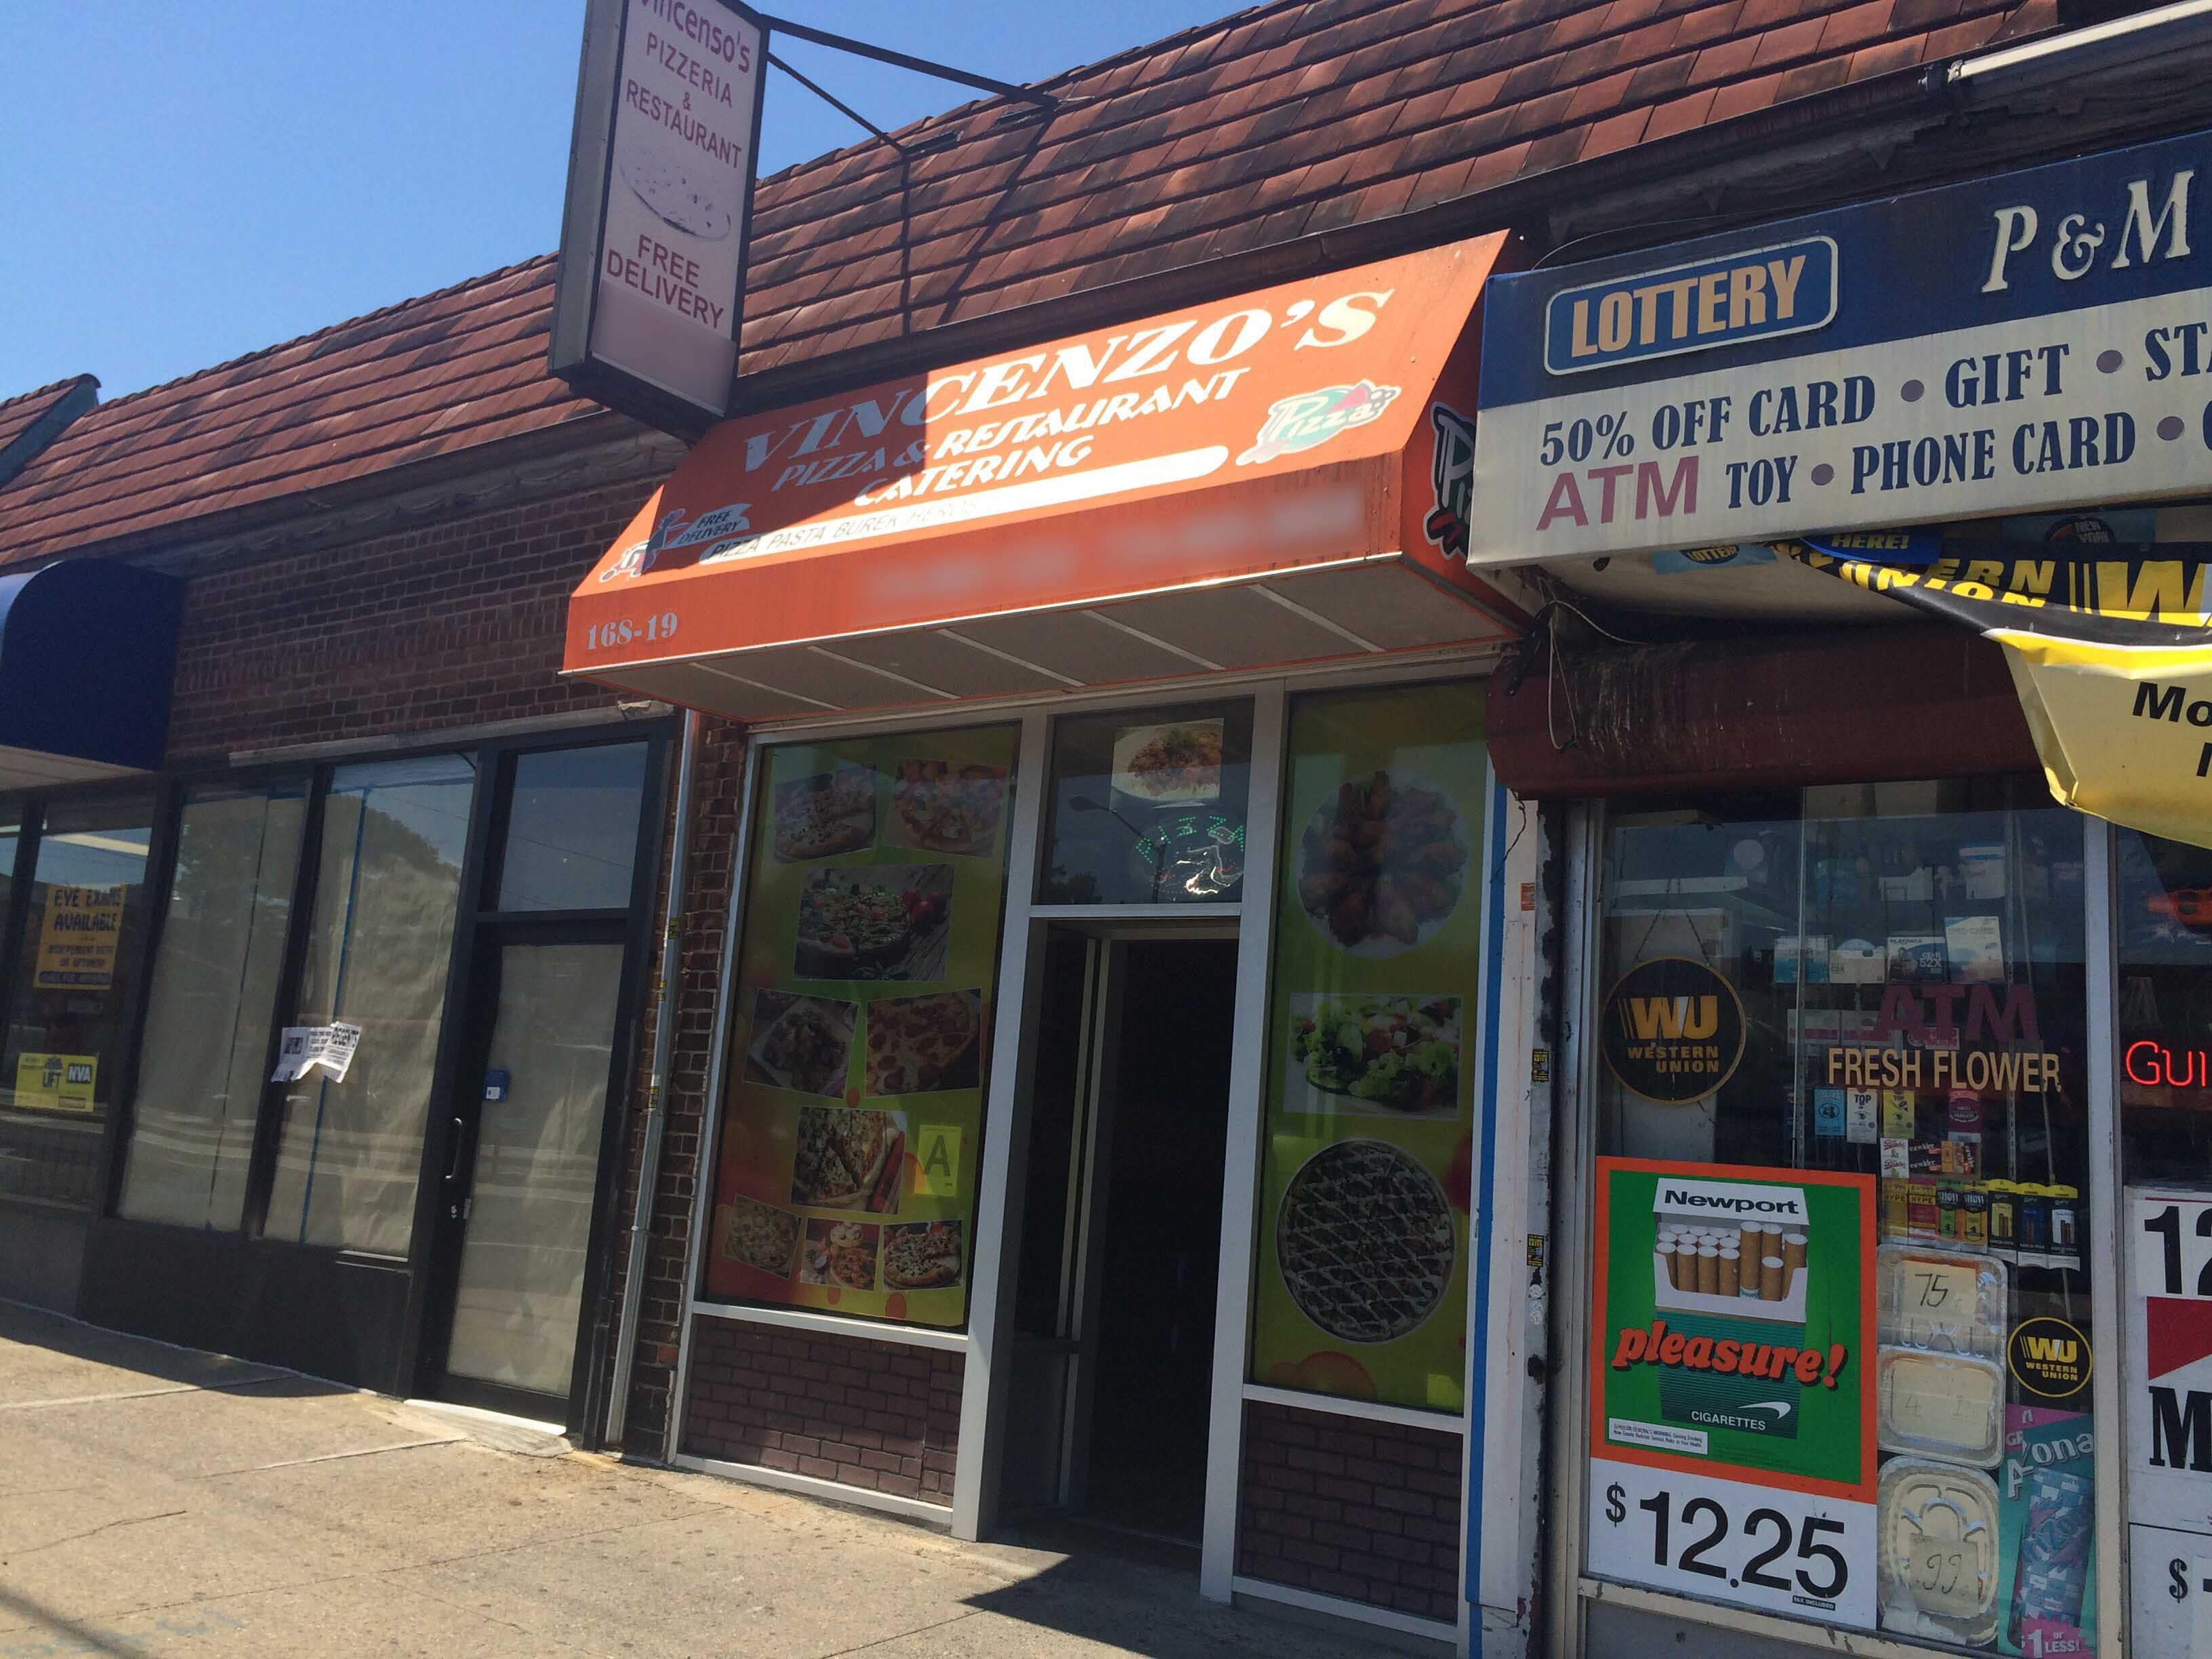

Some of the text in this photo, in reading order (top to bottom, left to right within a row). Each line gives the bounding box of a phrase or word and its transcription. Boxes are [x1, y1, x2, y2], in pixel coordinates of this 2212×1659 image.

[646, 32, 733, 108] PIZZERIA
[682, 91, 692, 111] &
[626, 78, 743, 169] RESTAURANT
[1981, 168, 2196, 294] P & M
[637, 234, 700, 289] FREE
[607, 248, 724, 330] DELIVERY
[1570, 253, 1807, 358] LOTTERY
[743, 287, 1396, 472] VINCENZO'S
[1540, 411, 1635, 468] 50%
[1652, 396, 1731, 451] OFF
[1748, 375, 1875, 437] CARD
[1944, 343, 2069, 408] GIFT
[771, 367, 1251, 492] PIZZA & RESTAURANT
[854, 434, 1094, 507] CATERING
[1725, 455, 1798, 509] TOY
[1851, 428, 1995, 495] PHONE
[2012, 411, 2135, 475] CARD
[1536, 455, 1700, 532] ATM
[678, 519, 743, 546] DELIVERY
[695, 509, 733, 529] FREE
[709, 535, 761, 559] PIZZA
[766, 525, 826, 550] PASTA
[1830, 534, 1910, 550] HERE!
[586, 611, 678, 651] 168-19
[1630, 995, 1718, 1040] WU
[1872, 984, 2041, 1043] ATM
[1628, 1046, 1719, 1059] WESTERN
[1656, 1060, 1719, 1073] UNION
[1828, 1047, 2062, 1093] FRESH FLOWER
[1853, 1094, 1871, 1104] TOP
[924, 1134, 951, 1176] A
[1663, 1189, 1800, 1215] Newport
[1911, 1195, 1934, 1204] HYPE
[1612, 1319, 1847, 1389] pleasure!
[2026, 1361, 2078, 1374] WESTERN
[2027, 1336, 2077, 1363] WU
[2042, 1370, 2078, 1381] UNION
[1691, 1409, 1767, 1432] CIGARETTES
[1793, 1596, 1835, 1610] TAX INCLUDED
[2045, 1638, 2081, 1653] LESS!
[2053, 1631, 2064, 1639] or
